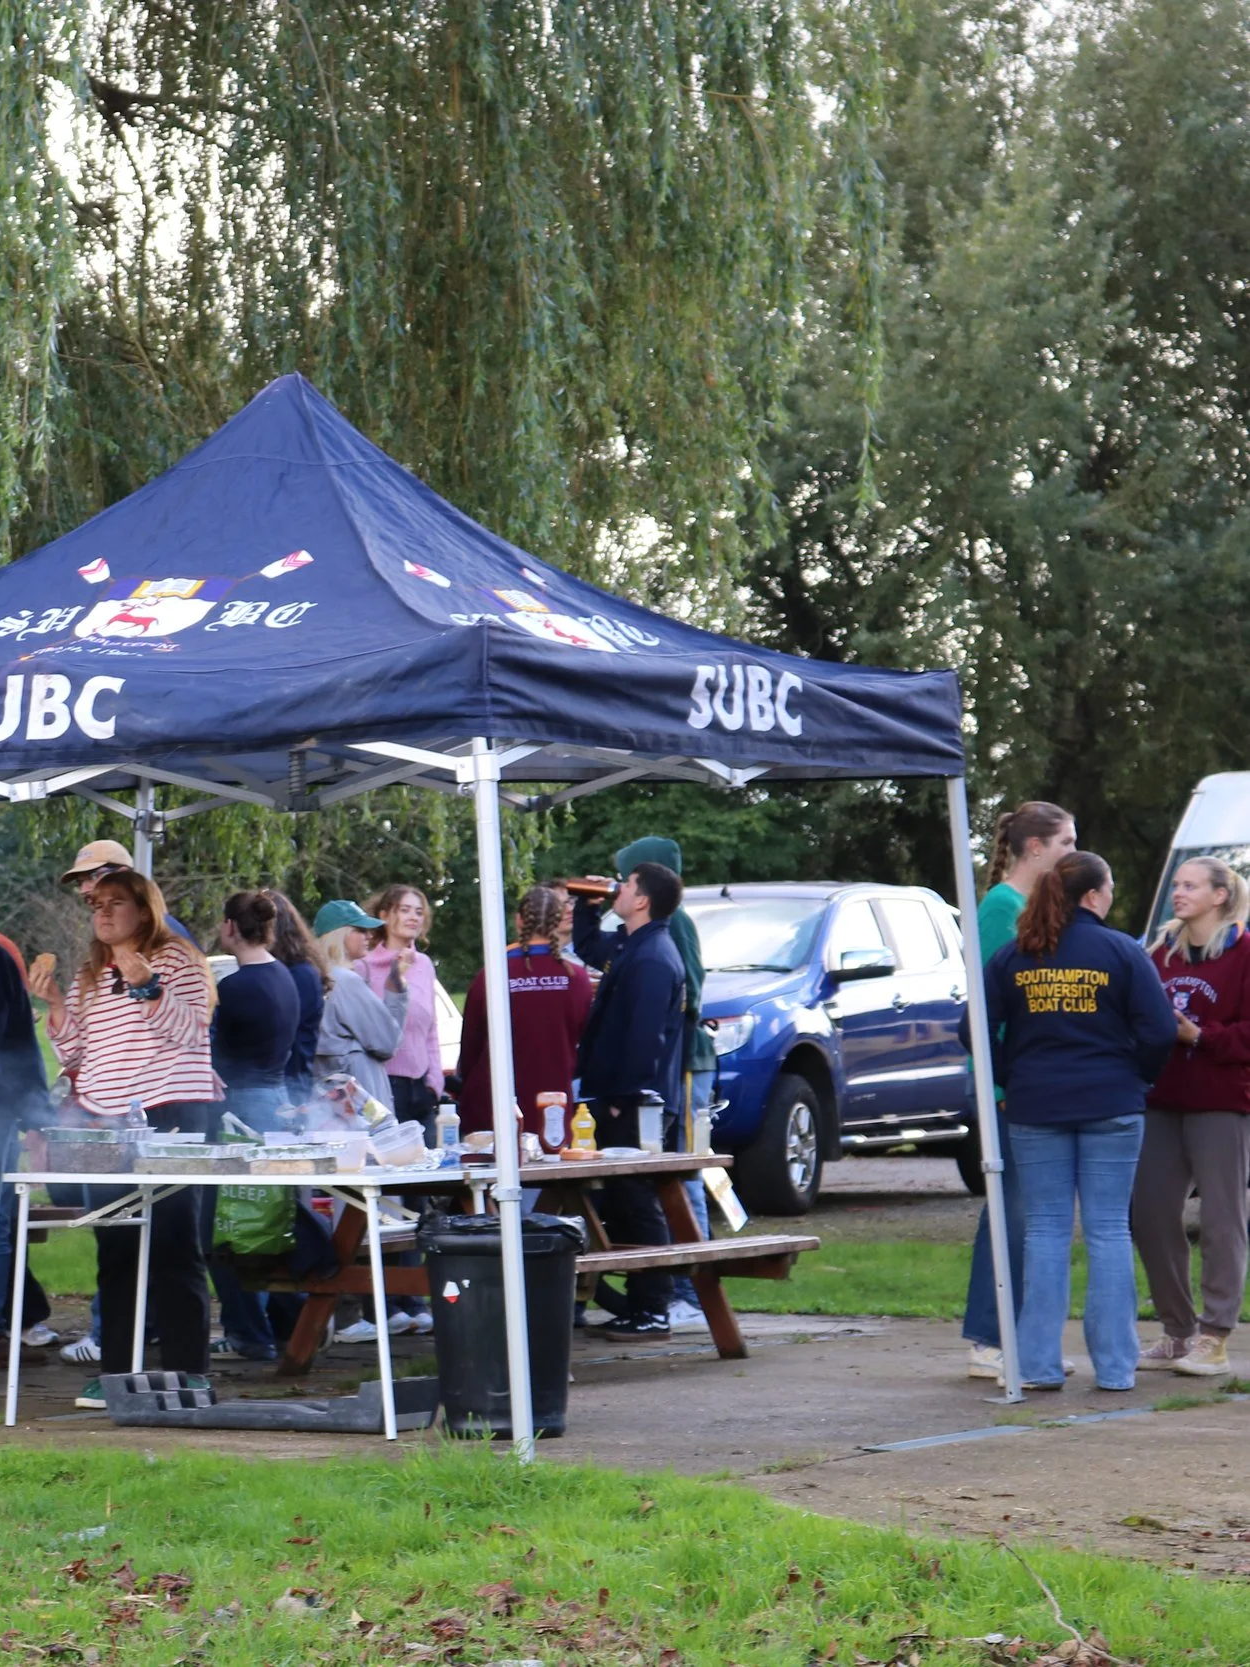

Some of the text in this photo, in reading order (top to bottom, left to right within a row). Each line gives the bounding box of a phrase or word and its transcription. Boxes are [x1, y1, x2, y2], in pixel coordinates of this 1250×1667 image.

[687, 664, 803, 737] SUBC
[510, 976, 569, 988] BOAT CLUB
[1014, 968, 1109, 986] SOUTHAMPTON
[1025, 983, 1098, 999] UNIVERSITY
[1029, 997, 1097, 1012] BOAT CLUB
